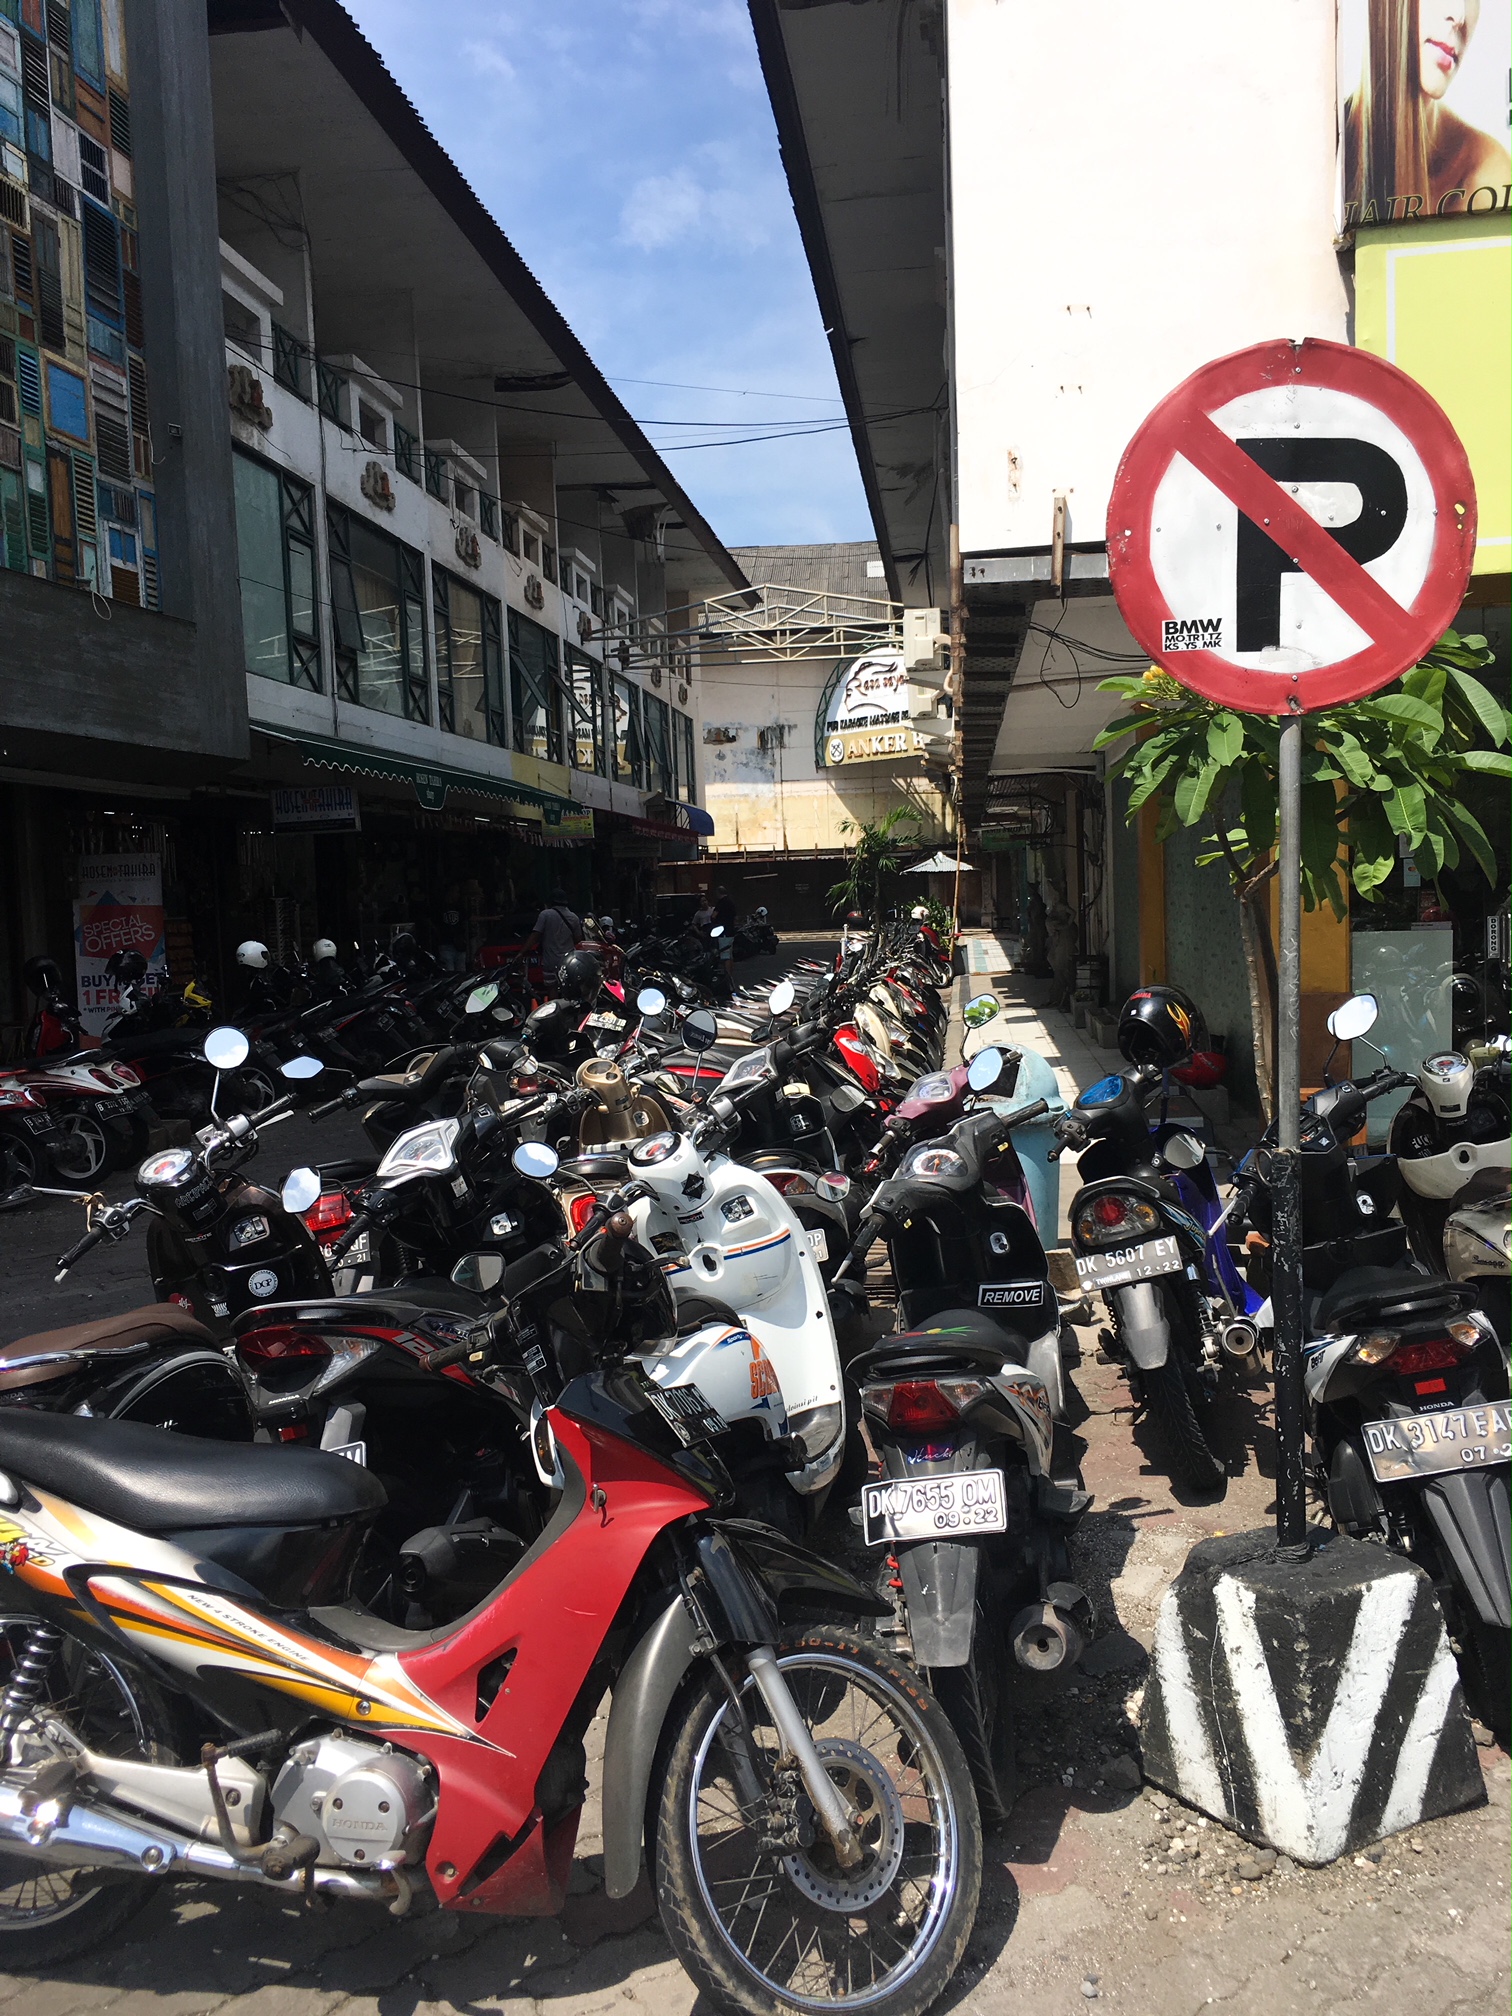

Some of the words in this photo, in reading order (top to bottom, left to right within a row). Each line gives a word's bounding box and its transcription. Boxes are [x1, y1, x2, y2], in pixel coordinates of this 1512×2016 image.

[1236, 438, 1408, 652] P
[1164, 617, 1223, 636] BMW
[846, 732, 908, 759] ANKER
[82, 864, 113, 880] HOSEN
[118, 862, 156, 879] TAHIRA
[83, 913, 147, 937] SPECIAL
[85, 923, 156, 953] OFFERS
[81, 974, 113, 988] BUY
[82, 989, 91, 1006] 1
[1075, 1256, 1098, 1276] DK
[1105, 1244, 1145, 1268] 5607
[1155, 1237, 1176, 1257] EY
[983, 1289, 1040, 1304] REMOVE
[392, 1331, 436, 1356] 12
[651, 1392, 682, 1421] DK
[664, 1386, 702, 1416] 7016
[1419, 1401, 1455, 1411] HONDA
[1367, 1425, 1402, 1454] DK
[1408, 1414, 1468, 1449] 3147
[868, 1487, 894, 1518] DK
[896, 1481, 955, 1514] 7655
[961, 1477, 997, 1507] OM
[187, 1594, 215, 1609] NEW
[222, 1614, 268, 1639] STROKE
[267, 1638, 310, 1661] ENGINE
[332, 1818, 388, 1831] HONDA
